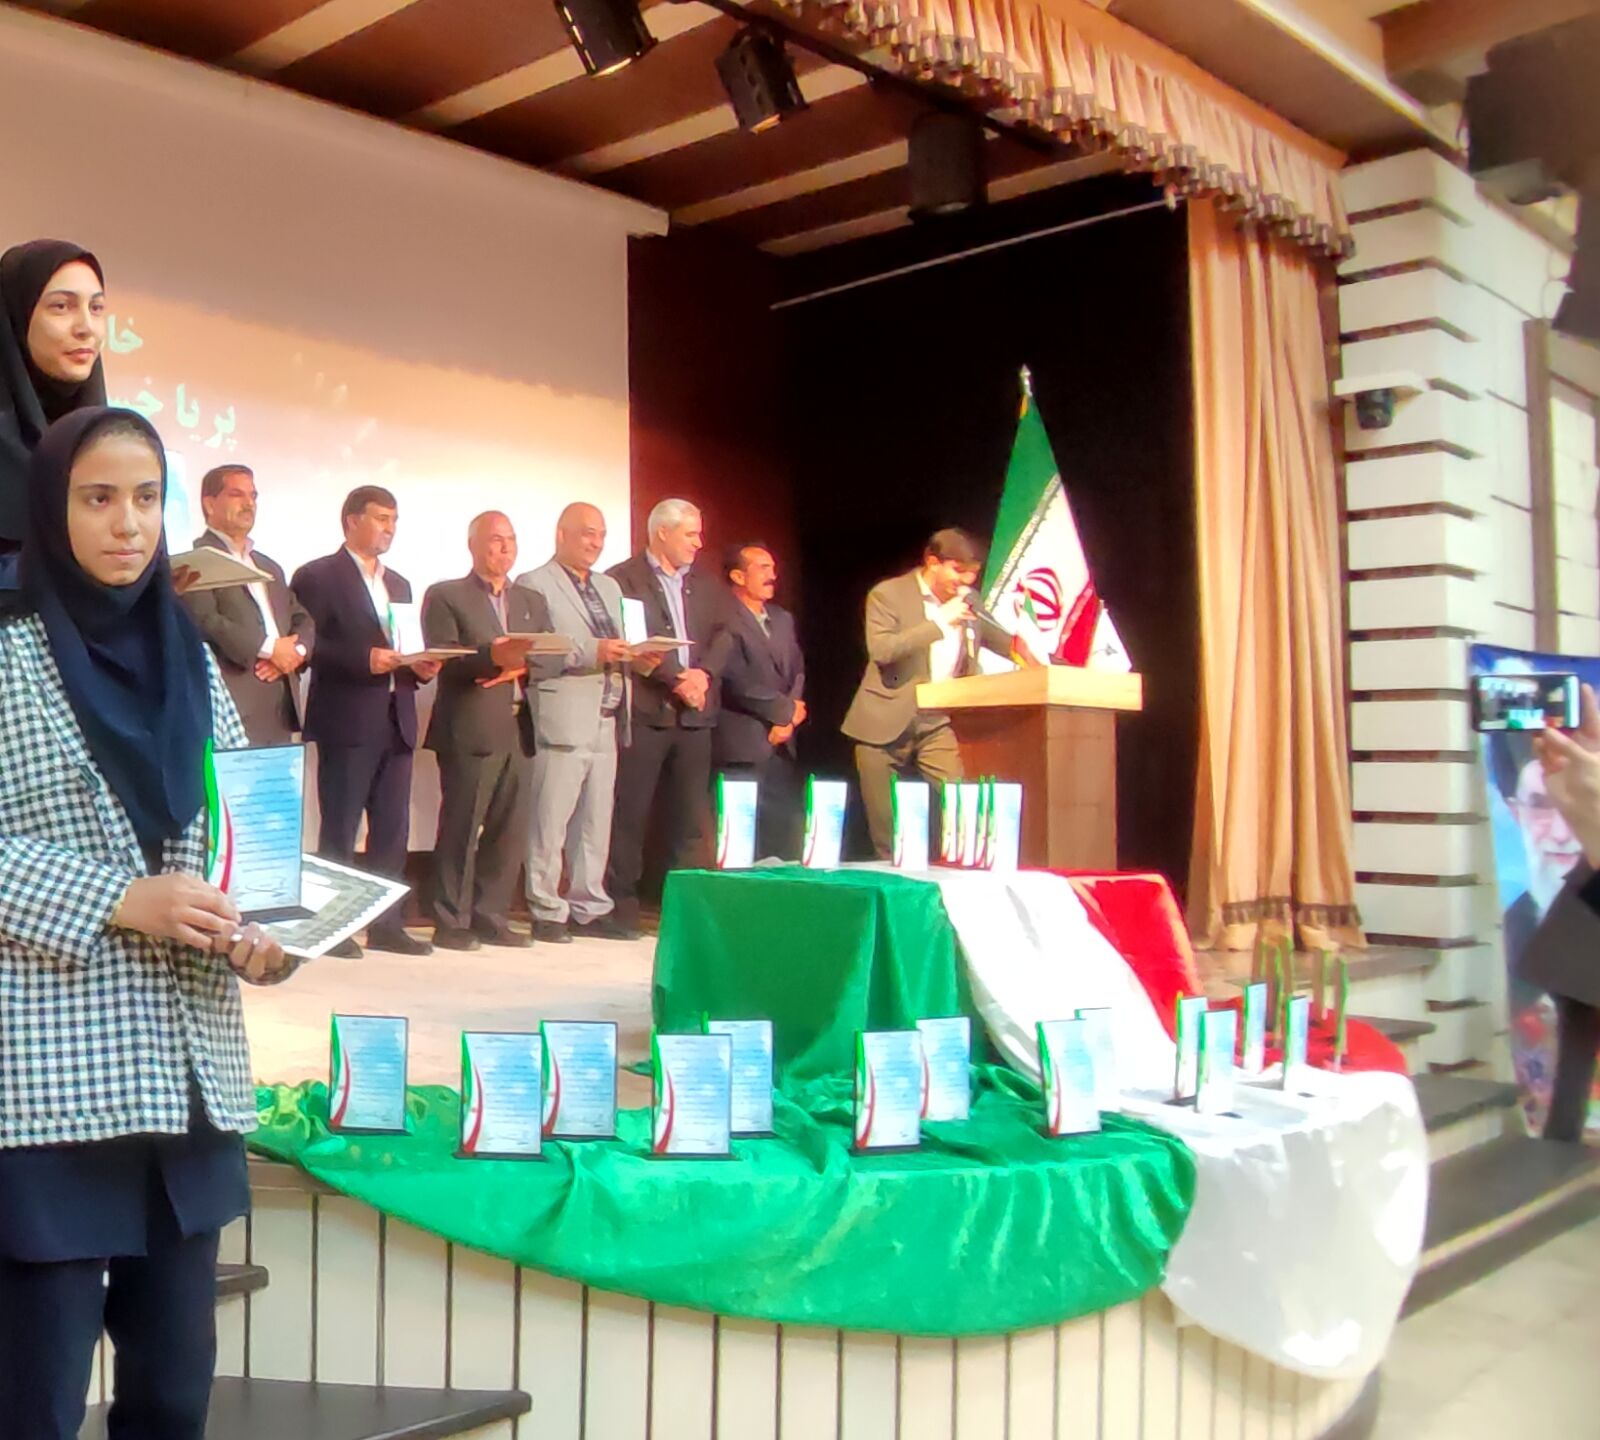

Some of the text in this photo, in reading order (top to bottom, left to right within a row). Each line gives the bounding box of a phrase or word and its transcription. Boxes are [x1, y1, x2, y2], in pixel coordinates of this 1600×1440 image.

[106, 315, 144, 354] خا
[107, 376, 238, 451] پریا خس
